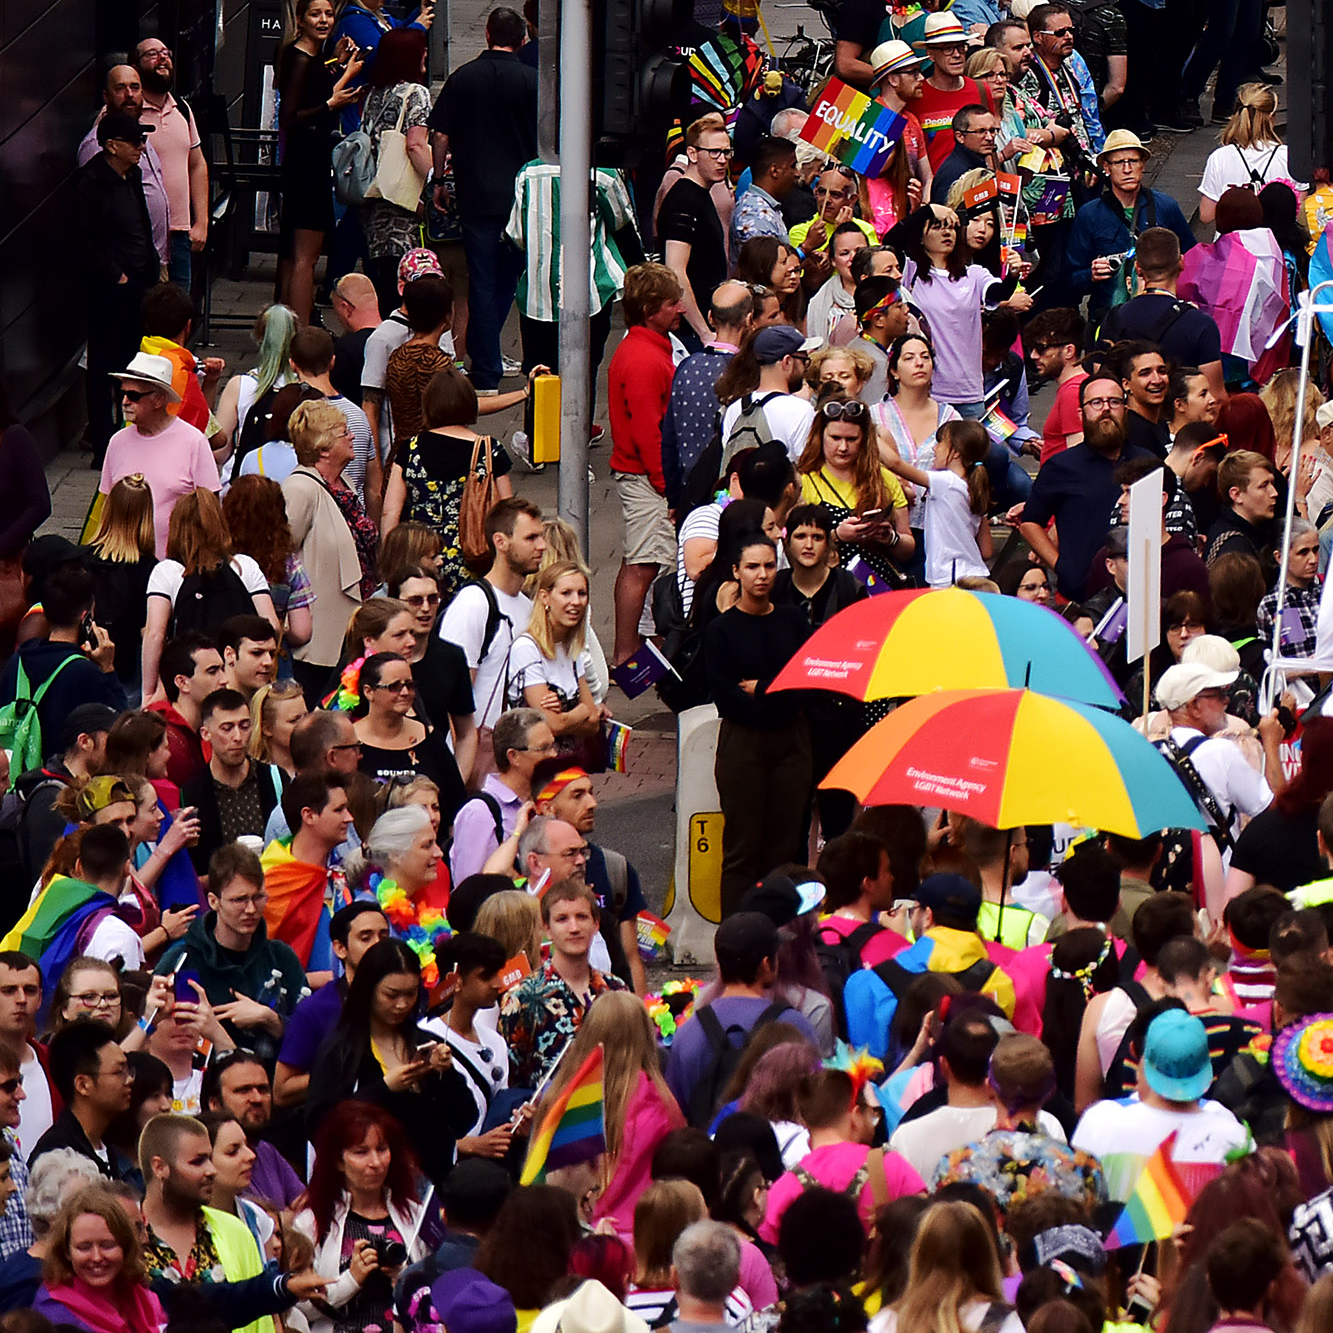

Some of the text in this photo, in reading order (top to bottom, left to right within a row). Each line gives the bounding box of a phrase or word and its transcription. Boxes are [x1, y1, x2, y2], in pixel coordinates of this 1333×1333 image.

[815, 100, 895, 154] EQUALITY
[974, 191, 989, 202] GMB
[906, 767, 987, 794] Environment Agency
[914, 779, 969, 800] LGBT Network
[696, 820, 709, 835] T
[697, 837, 709, 853] 6
[503, 969, 522, 986] GMB
